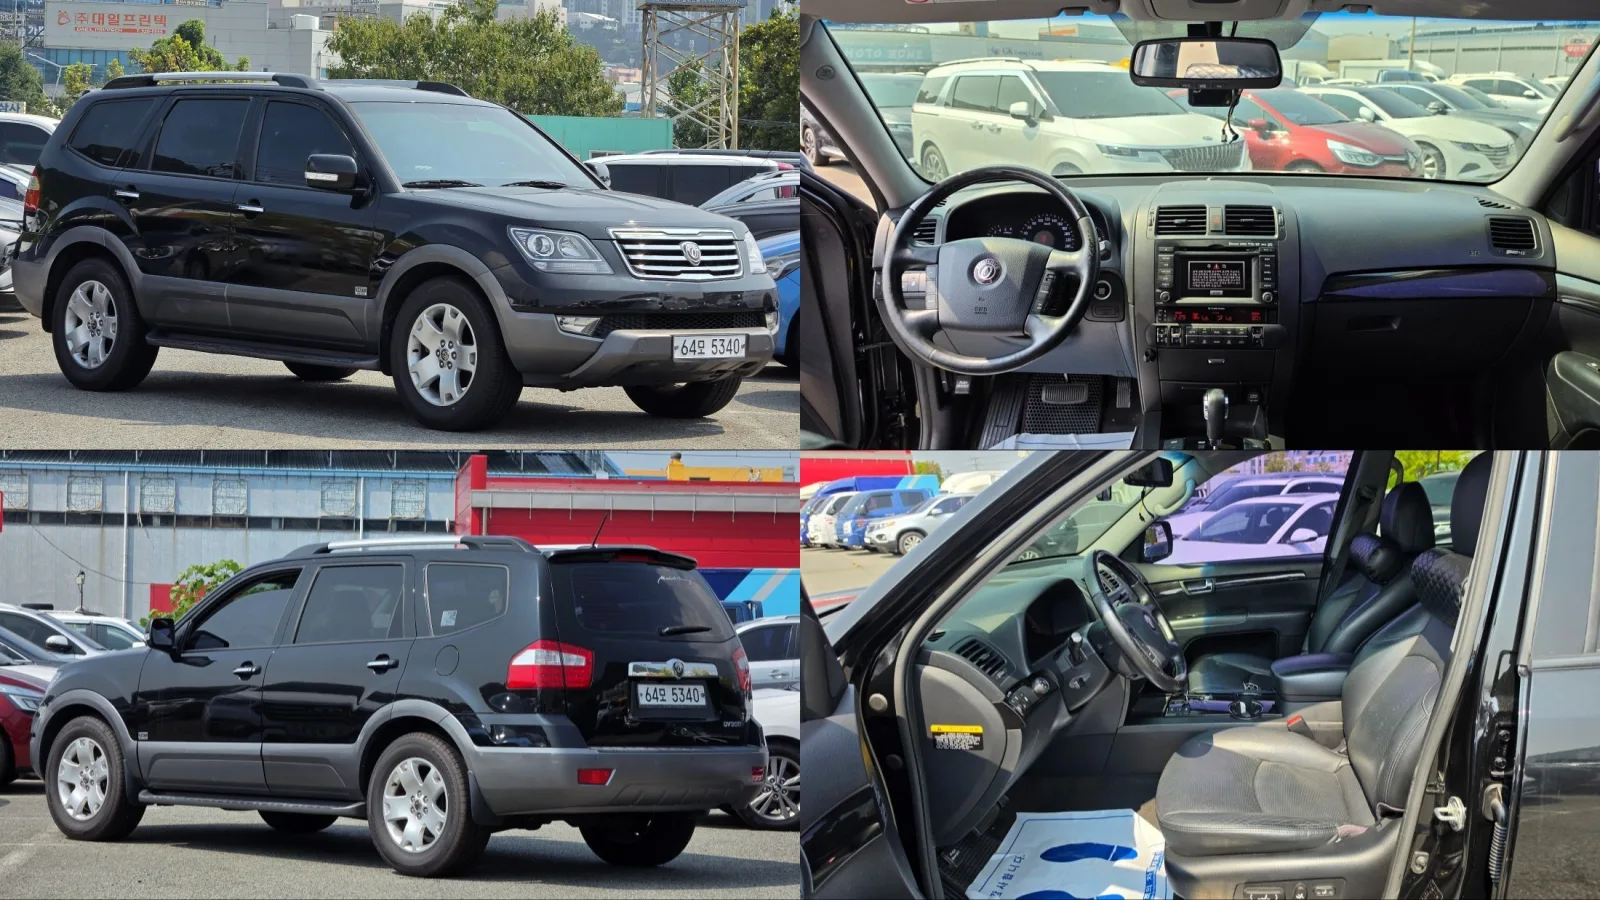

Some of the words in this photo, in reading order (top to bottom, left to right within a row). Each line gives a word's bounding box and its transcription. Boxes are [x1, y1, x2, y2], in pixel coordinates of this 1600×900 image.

[681, 338, 706, 355] 64모
[711, 338, 740, 355] 5340
[645, 686, 667, 703] 64모
[671, 687, 700, 703] 5340
